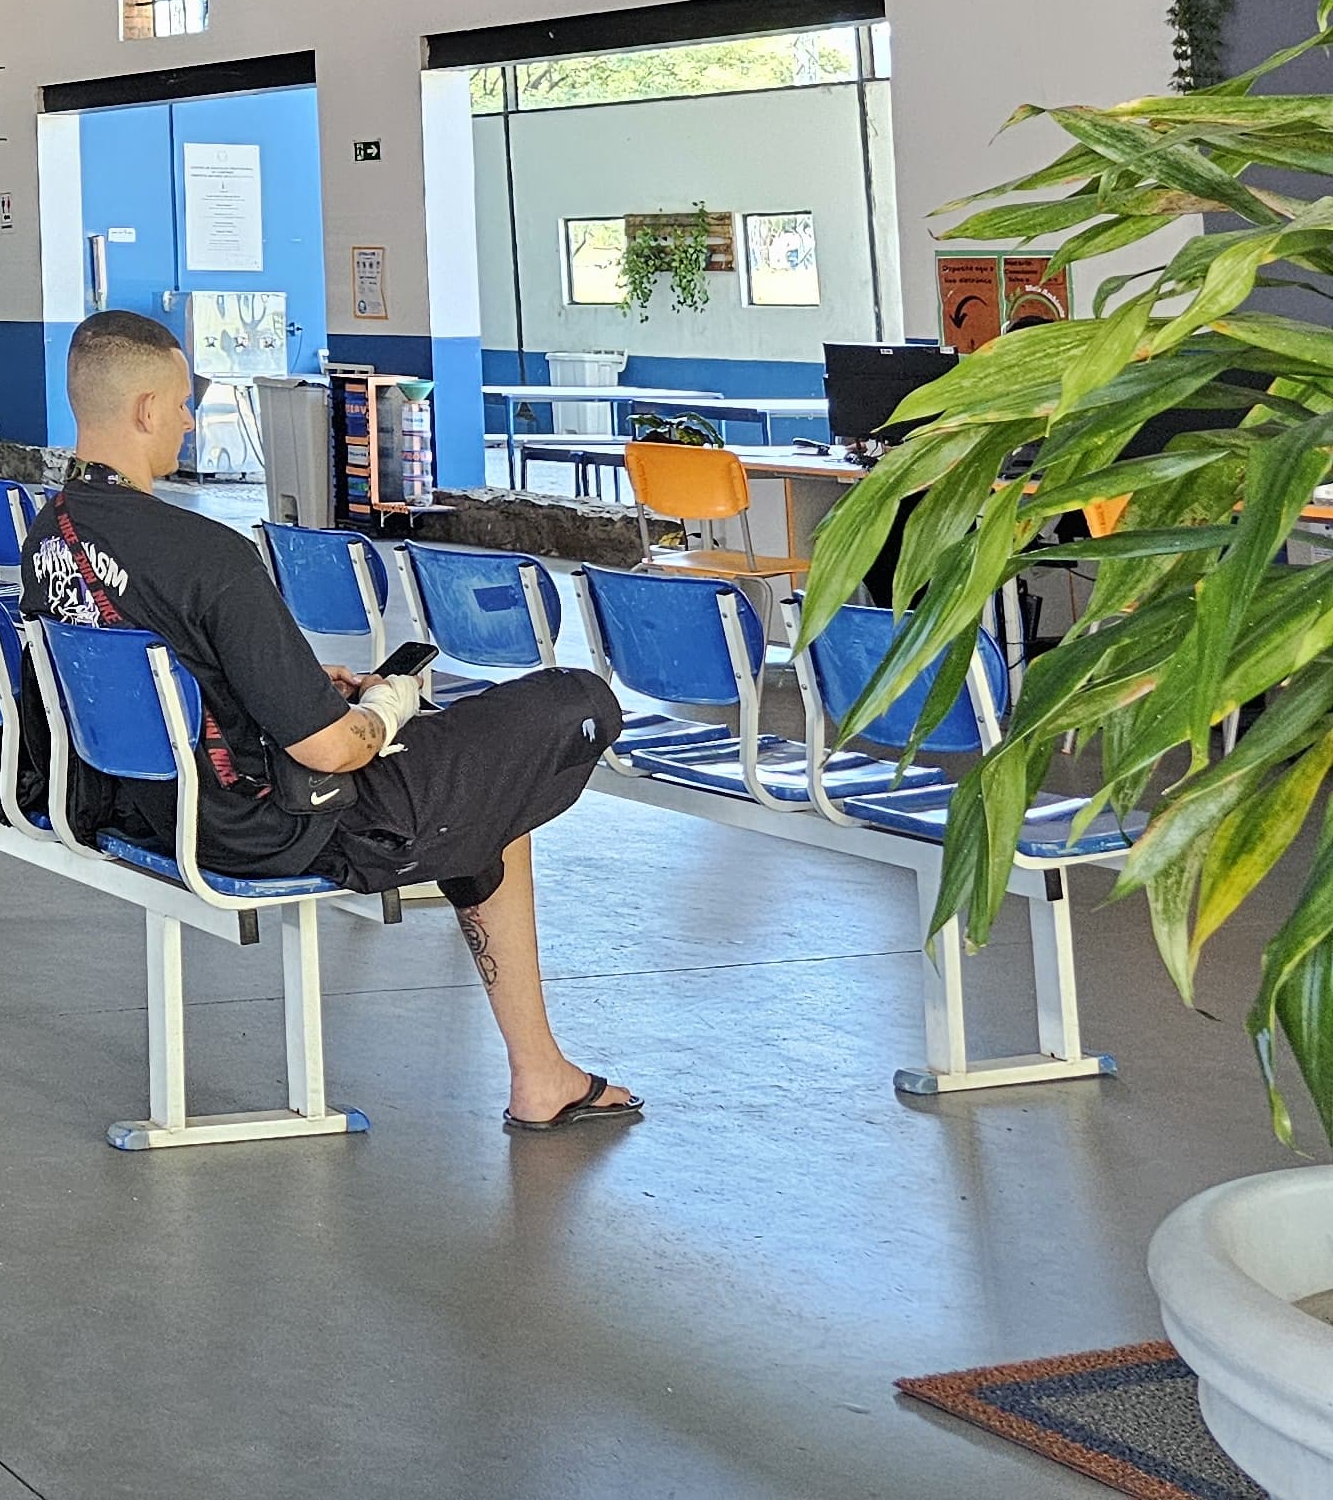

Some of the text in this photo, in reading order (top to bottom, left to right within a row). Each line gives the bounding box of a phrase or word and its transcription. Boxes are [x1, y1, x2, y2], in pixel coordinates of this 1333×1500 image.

[57, 513, 80, 546] NIKE
[93, 588, 124, 625] NIKE
[207, 748, 240, 790] NIKE
